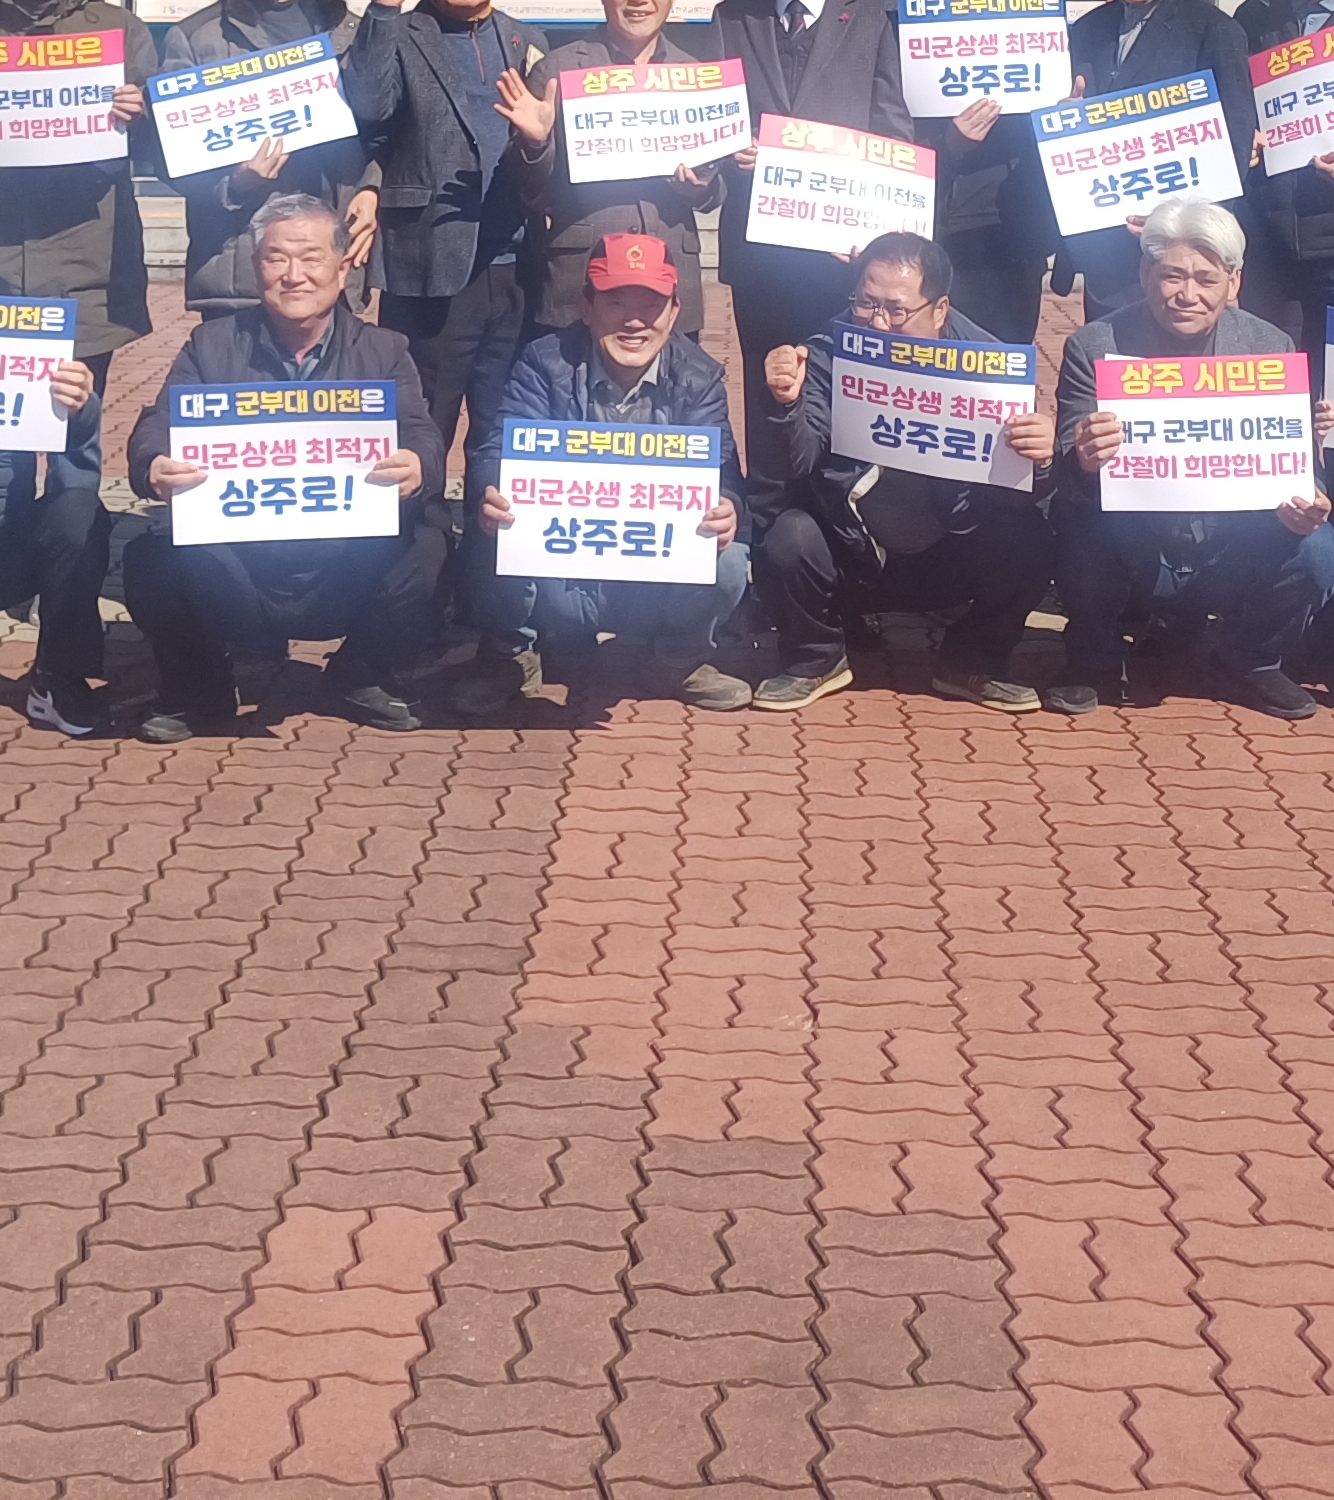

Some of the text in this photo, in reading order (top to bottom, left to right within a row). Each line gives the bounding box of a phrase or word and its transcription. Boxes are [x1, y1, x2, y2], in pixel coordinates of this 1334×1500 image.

[21, 37, 103, 66] 시민은
[909, 31, 1065, 59] 민군상생 최적지
[1267, 40, 1314, 76] 상주
[158, 40, 324, 97] 대구 군부대 이전은
[581, 67, 723, 93] 상주 시민은
[939, 65, 1041, 96] 상주로!
[59, 84, 116, 106] 이전을
[167, 72, 339, 130] 민군상생 최적지
[1041, 79, 1209, 133] 대구 군부대 이전은
[1264, 92, 1299, 118] 대구
[9, 111, 117, 140] 희망합니다
[203, 106, 313, 151] 상주로!
[575, 109, 614, 130] 대구
[621, 105, 679, 127] 군부대
[1265, 115, 1323, 147] 간절히
[574, 121, 745, 157] 간절히 희망합니다!
[781, 121, 917, 171] 상주 시민은
[1051, 118, 1223, 175] 민군상생 최적지
[764, 166, 803, 191] 대구
[809, 173, 867, 198] 군부대
[1089, 158, 1199, 206] 상주로!
[757, 197, 815, 222] 간절히
[843, 332, 1027, 376] 대구 군부대 이전은
[1120, 359, 1286, 394] 상주 시민은
[180, 389, 385, 419] 대구 군부대 이전은
[841, 374, 1028, 425] 민군상생 최적지
[513, 428, 709, 459] 대구 군부대 이전은
[870, 415, 992, 463] 상주로!
[1163, 418, 1233, 442] 군부대
[1240, 417, 1303, 440] 이전을
[182, 438, 390, 470] 민군상생 최적지
[1107, 452, 1307, 479] 간절히 희망합니다!
[220, 477, 354, 518] 상주로!
[511, 478, 711, 511] 민군상생 최적지
[543, 518, 673, 558] 상주로!
